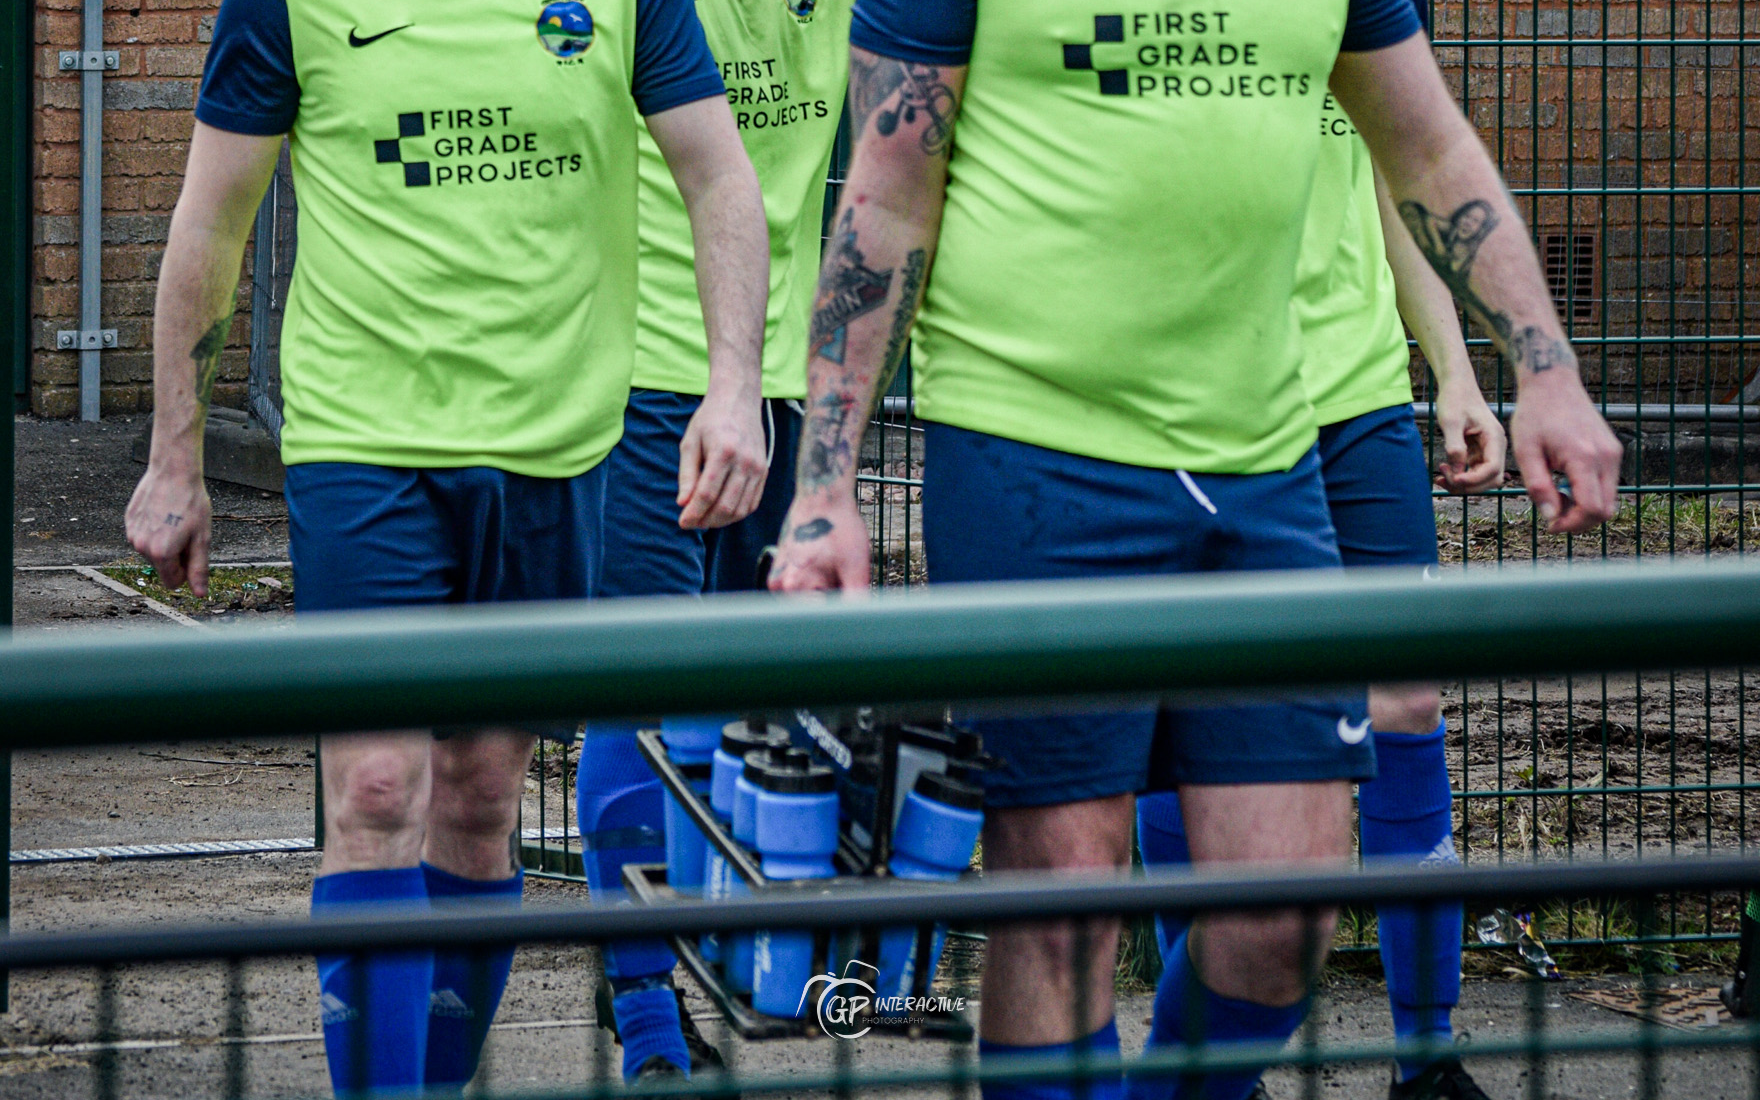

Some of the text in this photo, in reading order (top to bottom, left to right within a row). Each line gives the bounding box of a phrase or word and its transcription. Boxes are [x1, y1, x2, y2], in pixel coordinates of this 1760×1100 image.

[1133, 12, 1229, 36] FIRST
[1137, 43, 1259, 67] GRADE
[723, 59, 776, 81] FIRST
[727, 81, 789, 105] GRADE
[1137, 73, 1311, 97] PROJECTS
[430, 106, 513, 130] FIRST
[737, 100, 828, 129] ROJECTS
[434, 133, 538, 157] GRADE
[436, 154, 582, 185] PROJECTS
